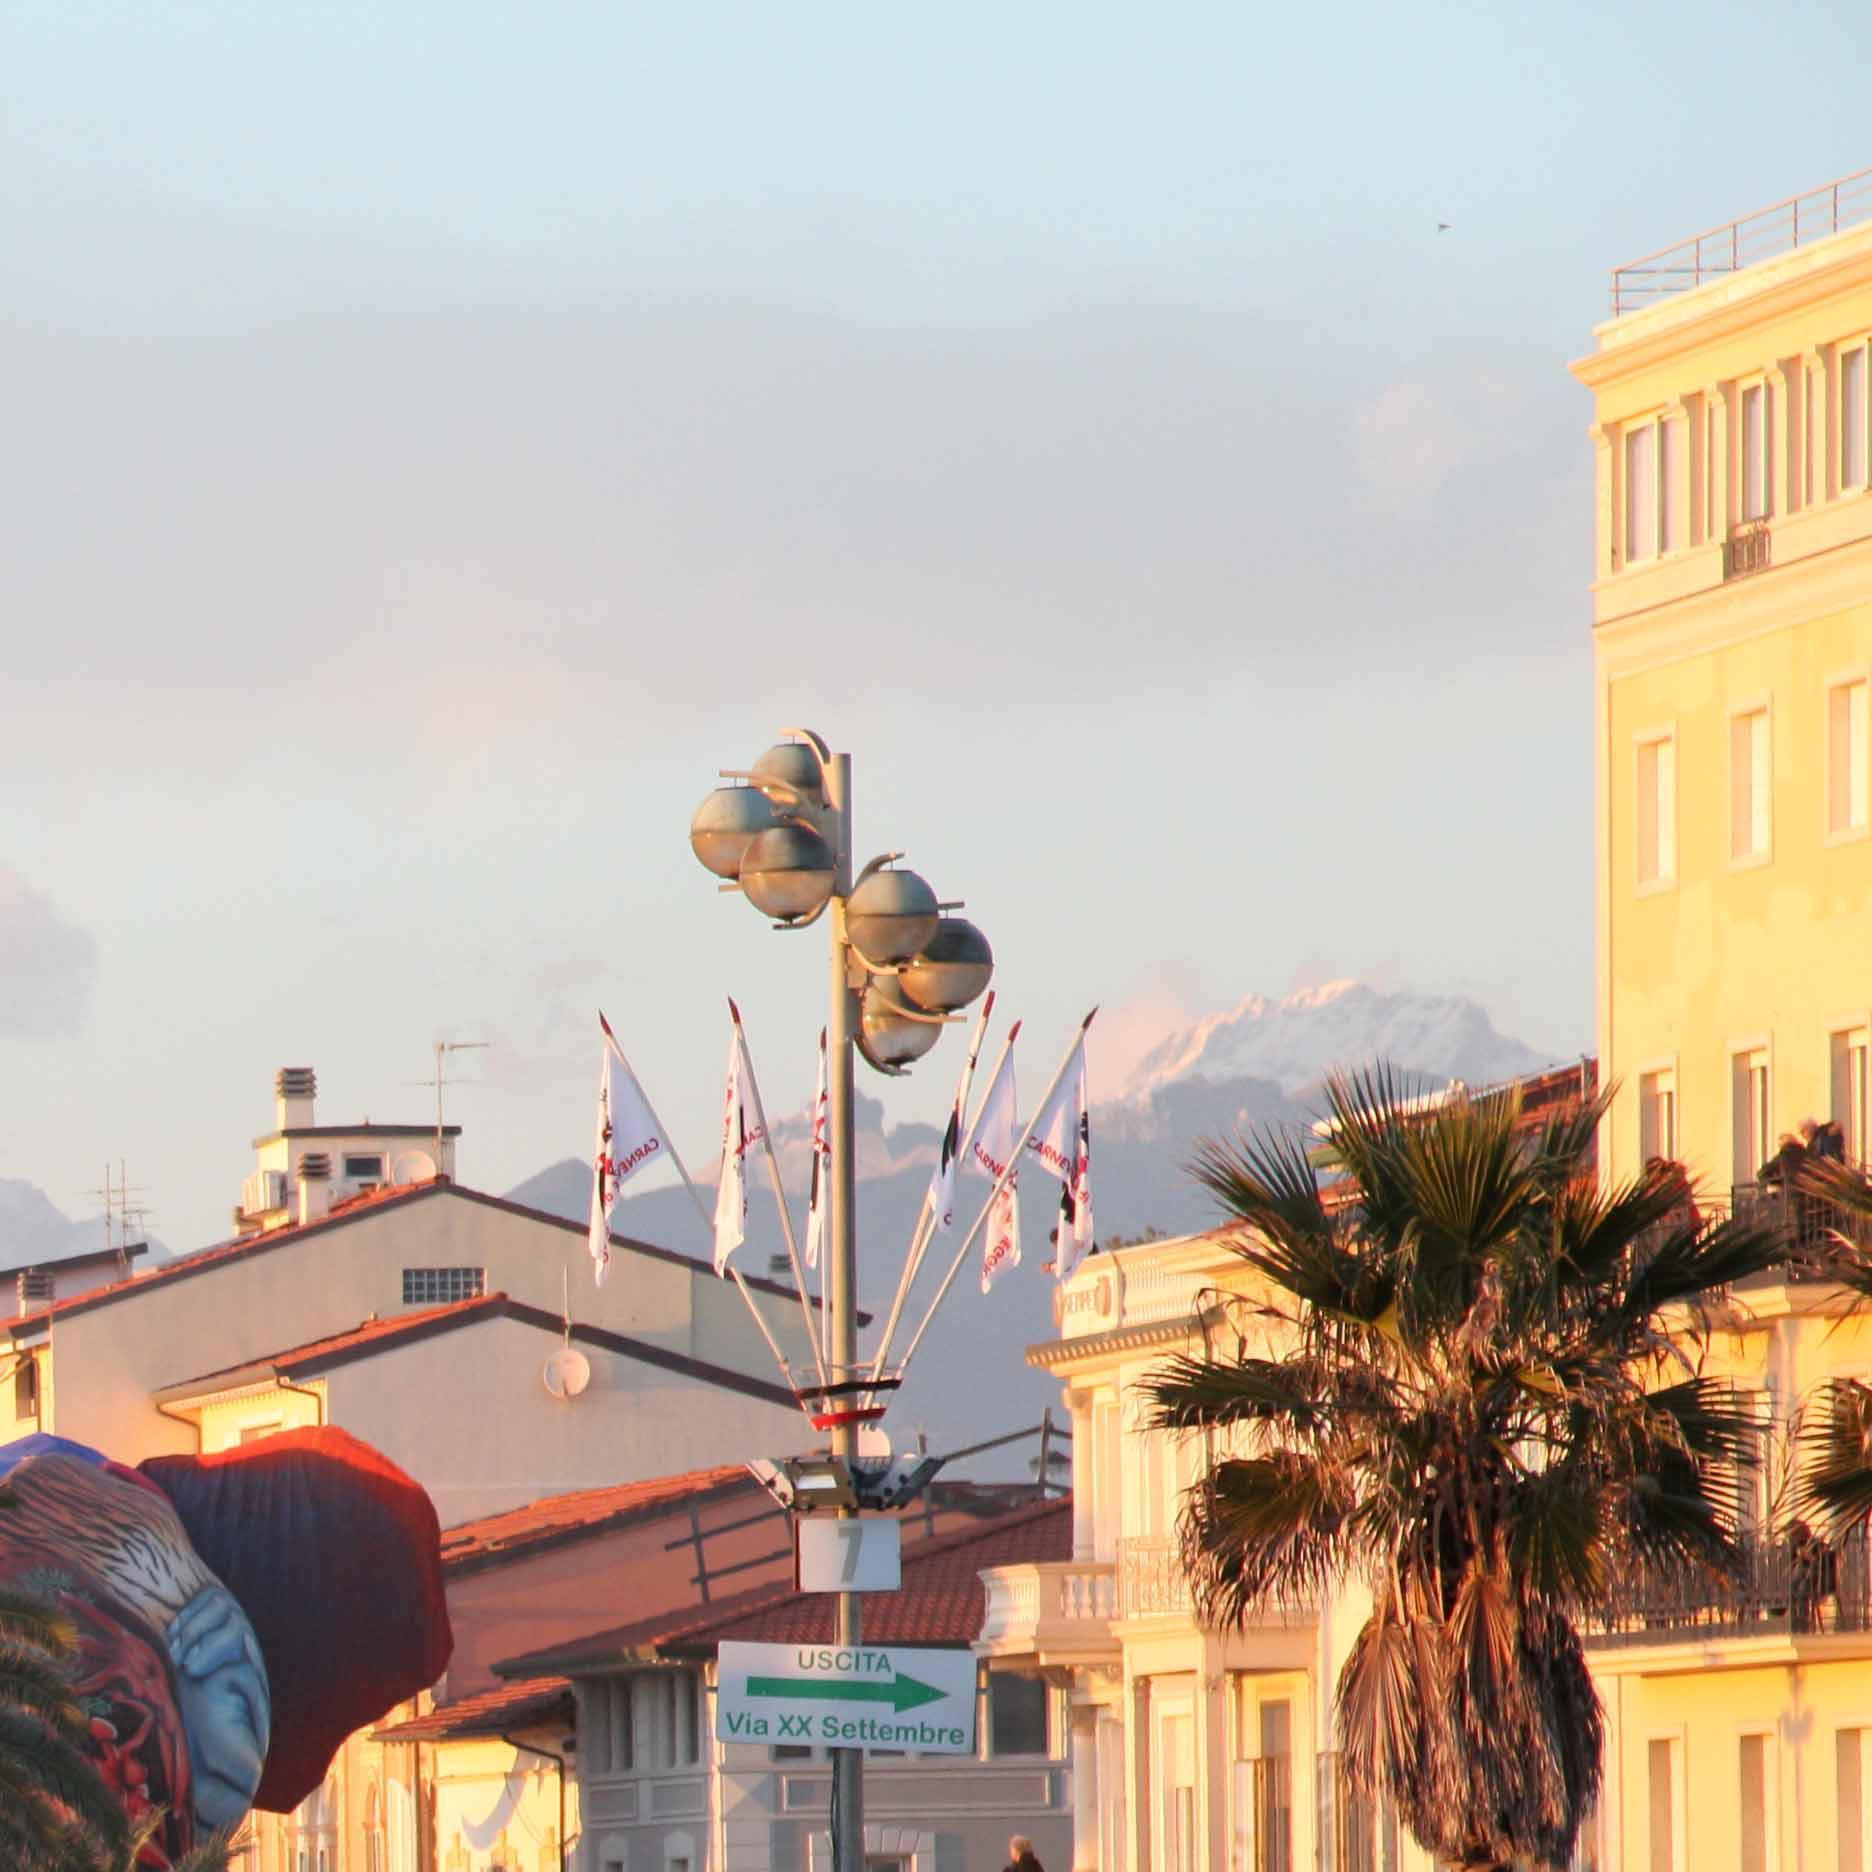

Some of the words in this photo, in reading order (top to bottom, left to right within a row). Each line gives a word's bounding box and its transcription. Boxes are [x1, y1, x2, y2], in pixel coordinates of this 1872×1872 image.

[836, 1527, 864, 1583] 7
[797, 1649, 892, 1673] USCITA
[726, 1711, 769, 1736] Via
[777, 1714, 813, 1738] XX
[821, 1715, 966, 1745] Settembre
